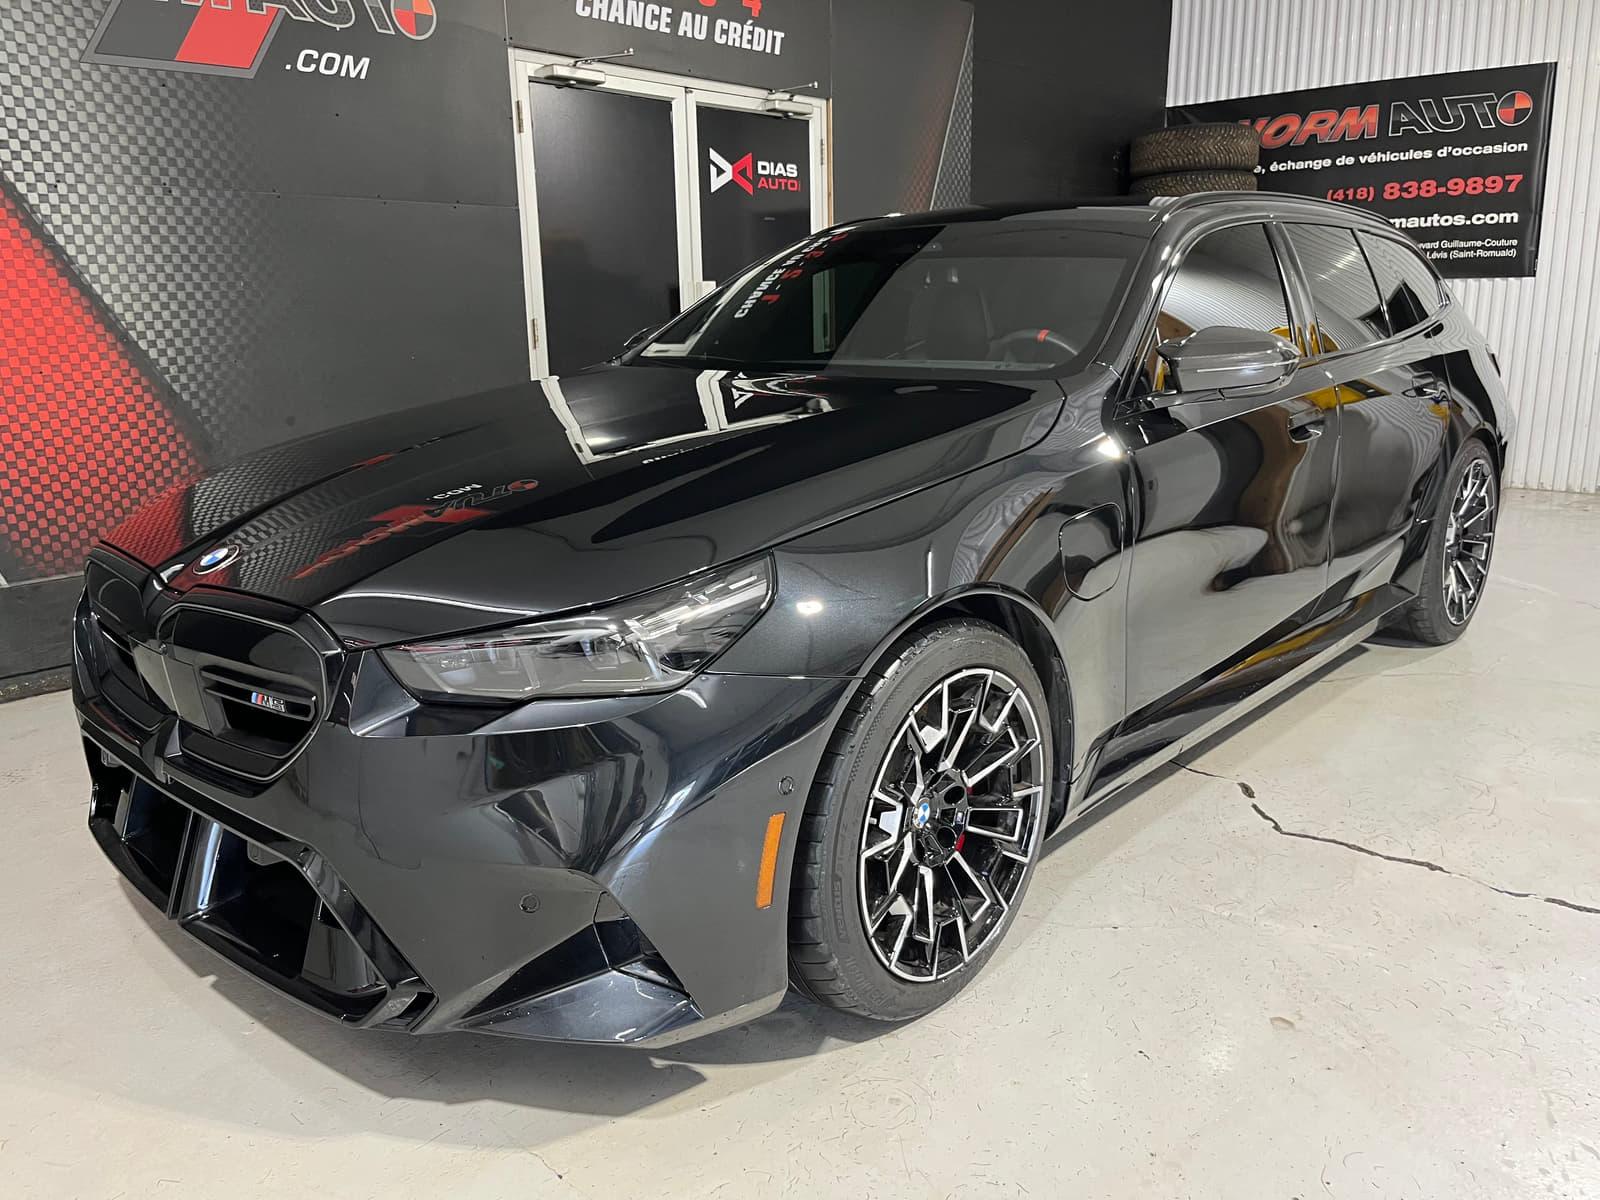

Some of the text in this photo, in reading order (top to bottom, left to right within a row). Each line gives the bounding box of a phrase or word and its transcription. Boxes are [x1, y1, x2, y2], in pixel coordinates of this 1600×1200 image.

[575, 0, 785, 55] CHANCE AU CRÉDIT
[285, 49, 370, 79] .COM
[1269, 159, 1332, 173] échange
[1335, 155, 1355, 166] de
[1359, 149, 1433, 164] véhicules
[1437, 142, 1528, 158] d'occasion
[757, 160, 798, 178] DIAS
[757, 176, 801, 192] AUTO
[1327, 174, 1524, 201] (418) 838-9897
[1389, 211, 1519, 230] mautos.com
[1441, 237, 1518, 249] Guillaume-Couture
[1427, 248, 1517, 260] Lévis (Saint-Romuald)
